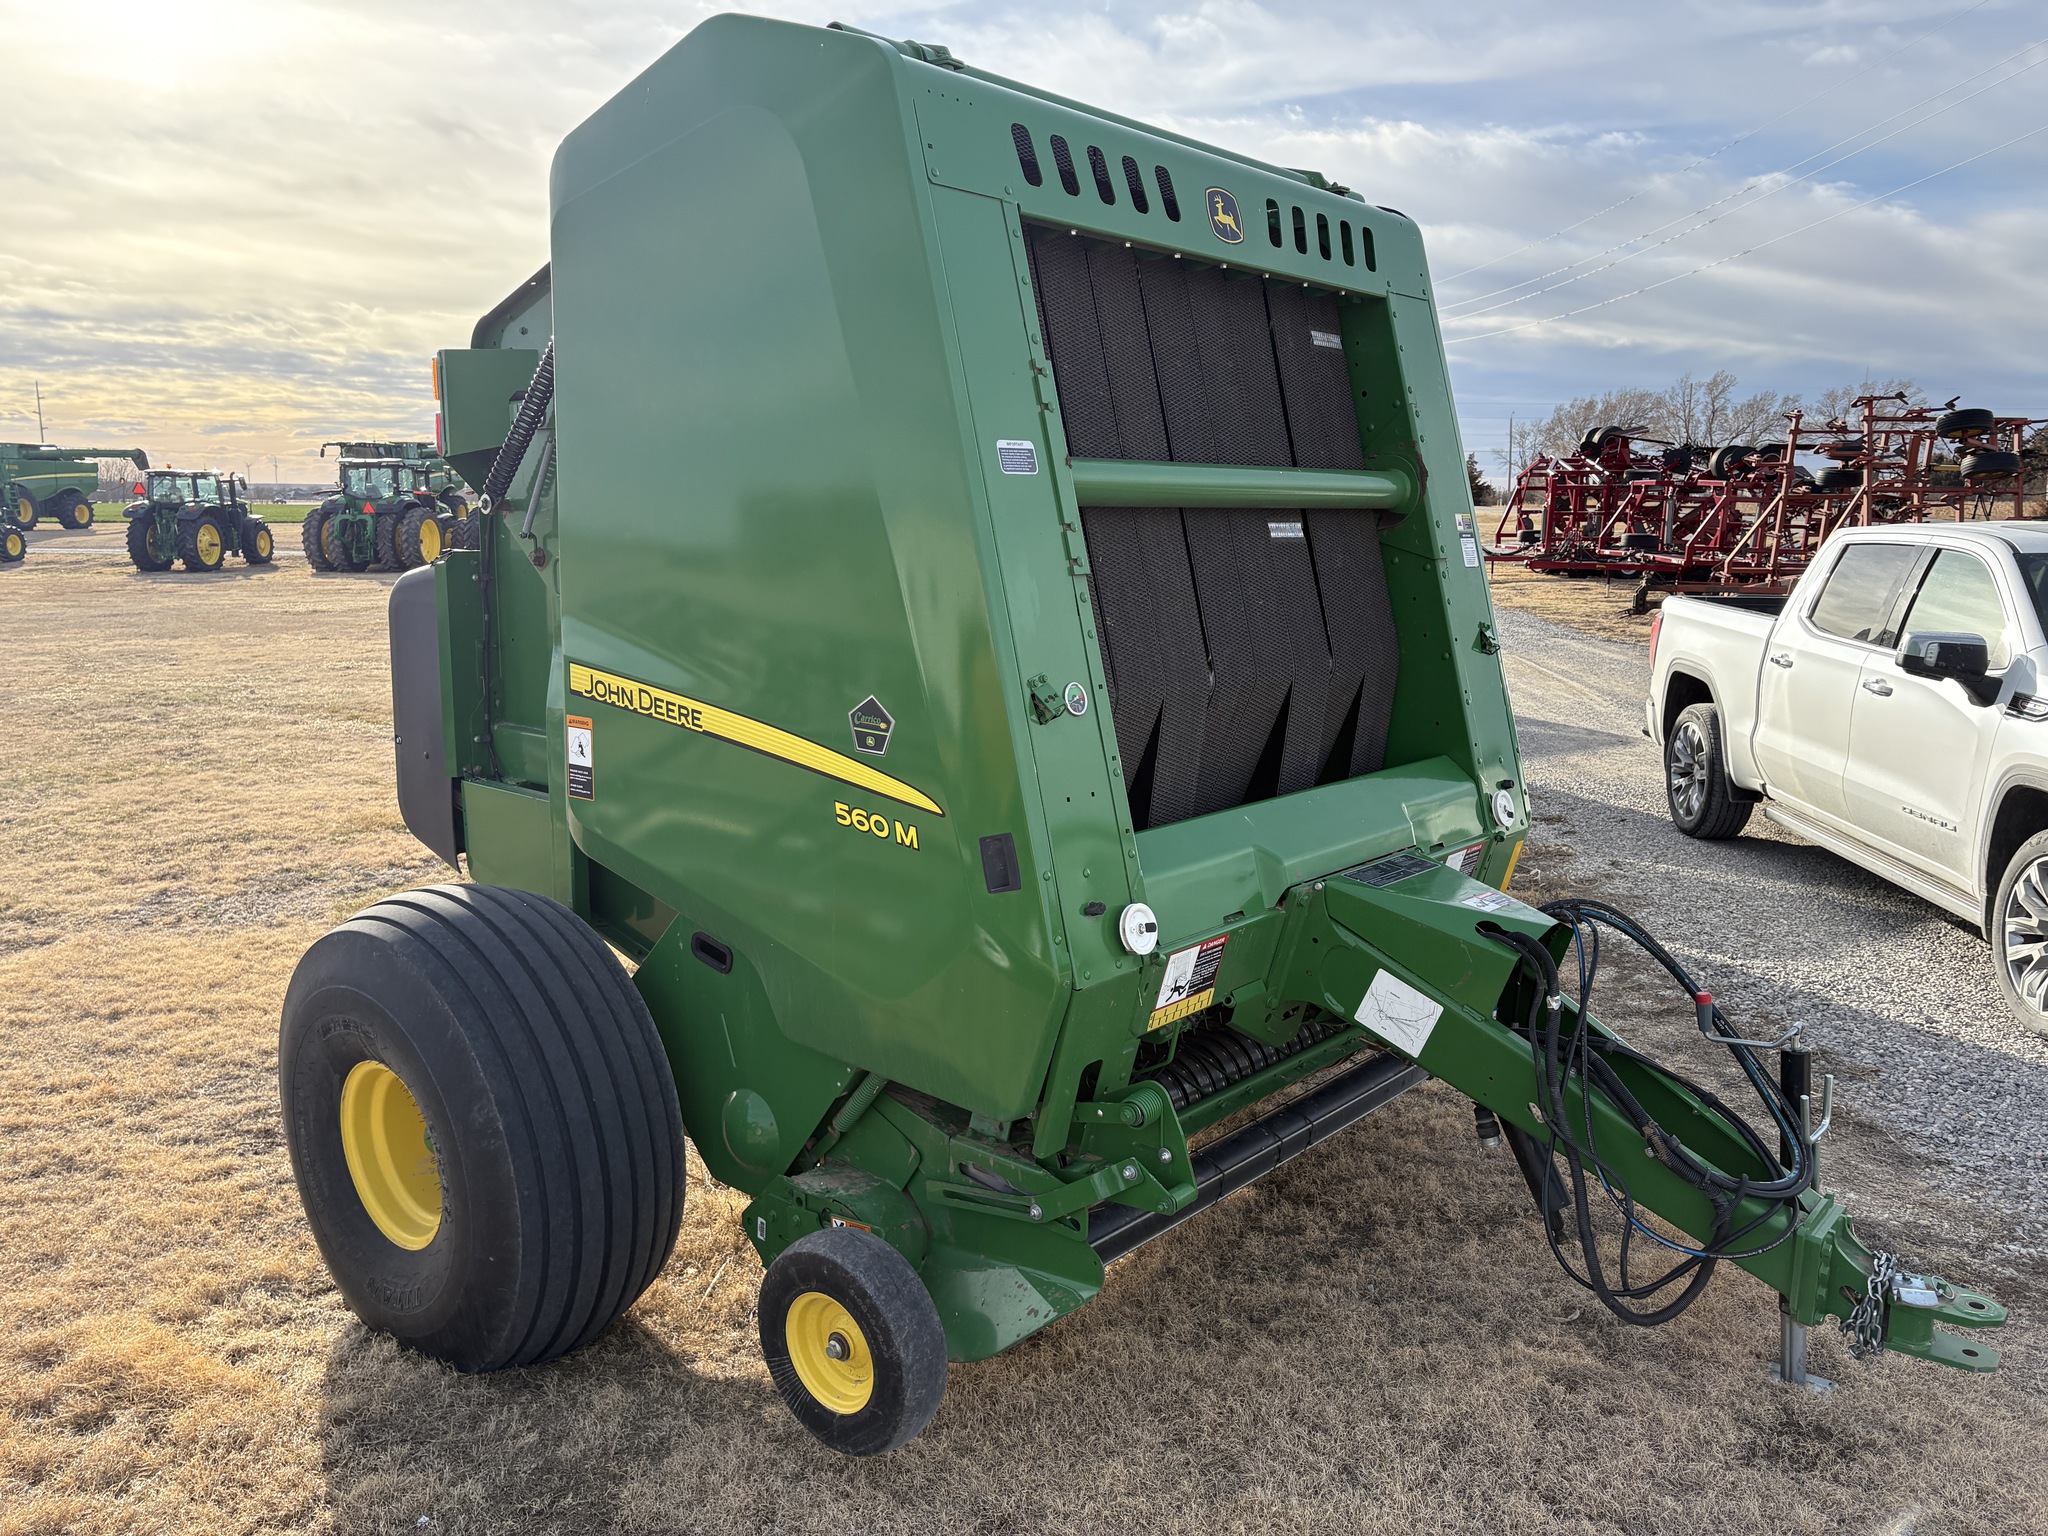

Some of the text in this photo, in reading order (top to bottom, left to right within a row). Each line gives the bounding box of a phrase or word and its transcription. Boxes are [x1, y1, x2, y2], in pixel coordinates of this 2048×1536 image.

[584, 673, 703, 729] JOHN DEERE
[834, 800, 920, 852] 560 M
[1901, 805, 1958, 833] DENALI
